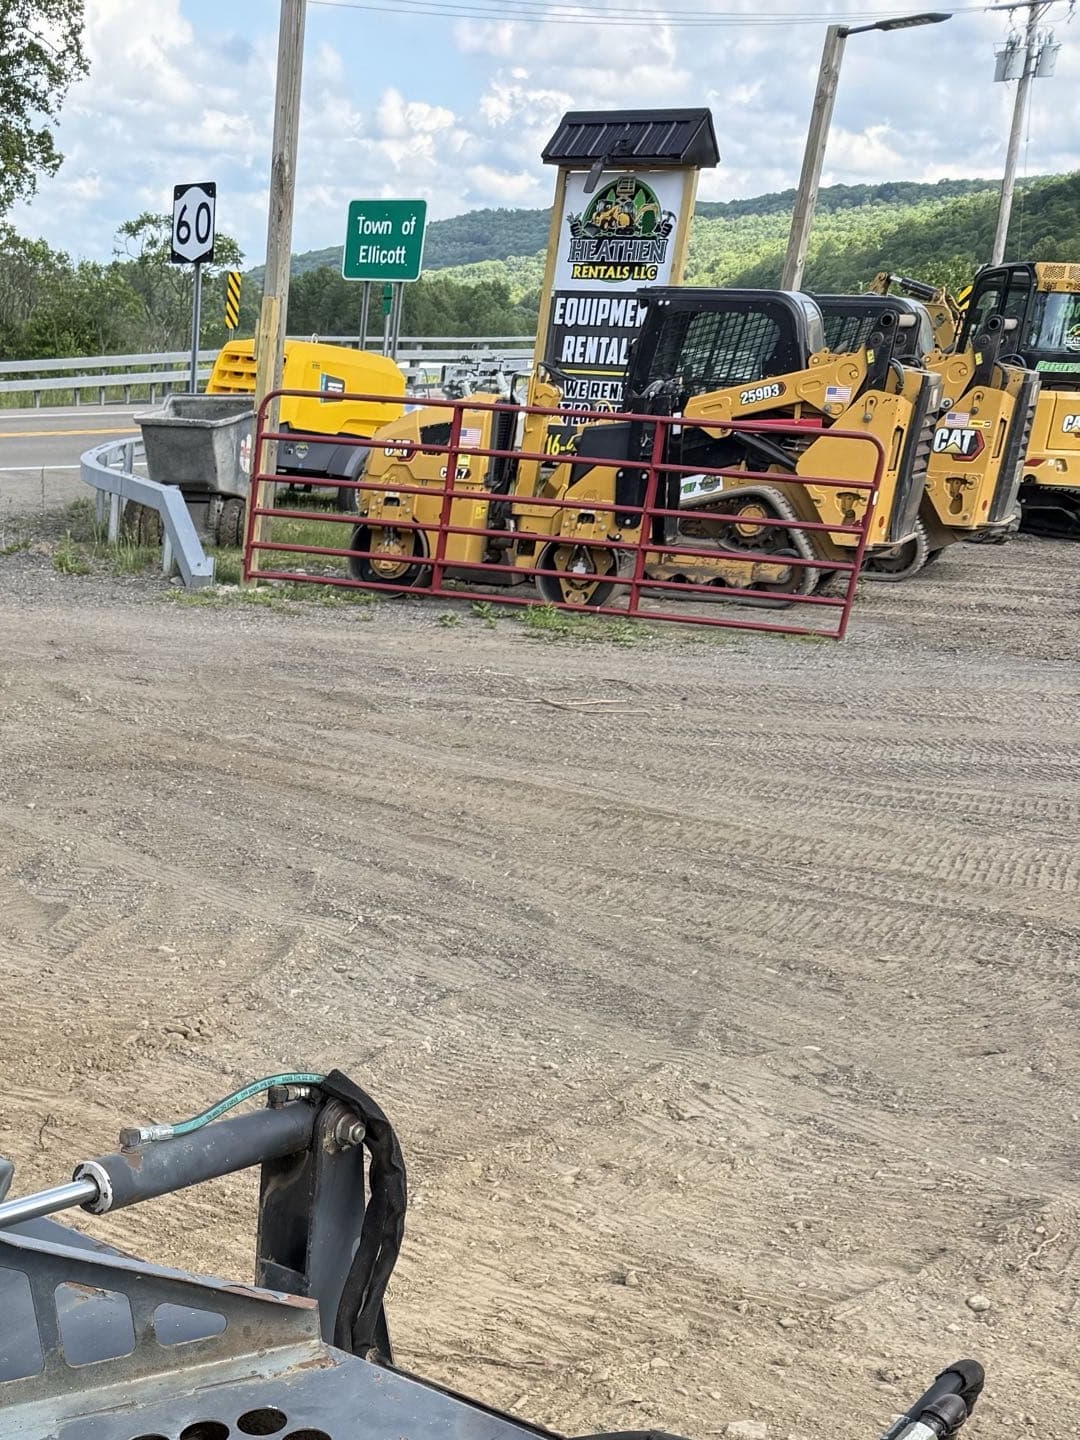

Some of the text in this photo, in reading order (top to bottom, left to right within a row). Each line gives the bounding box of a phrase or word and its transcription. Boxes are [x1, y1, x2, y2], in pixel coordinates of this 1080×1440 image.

[176, 201, 212, 245] 60
[357, 215, 417, 235] Town of
[358, 245, 406, 264] Ellicott
[568, 238, 668, 263] HEATHEN
[572, 265, 658, 280] RENTALS LLC
[554, 298, 648, 327] EQUIPMEN
[561, 336, 638, 365] RENTAL
[564, 380, 624, 401] WE REN
[739, 383, 781, 405] 259D3
[1063, 415, 1080, 433] CA
[933, 427, 976, 454] CAT
